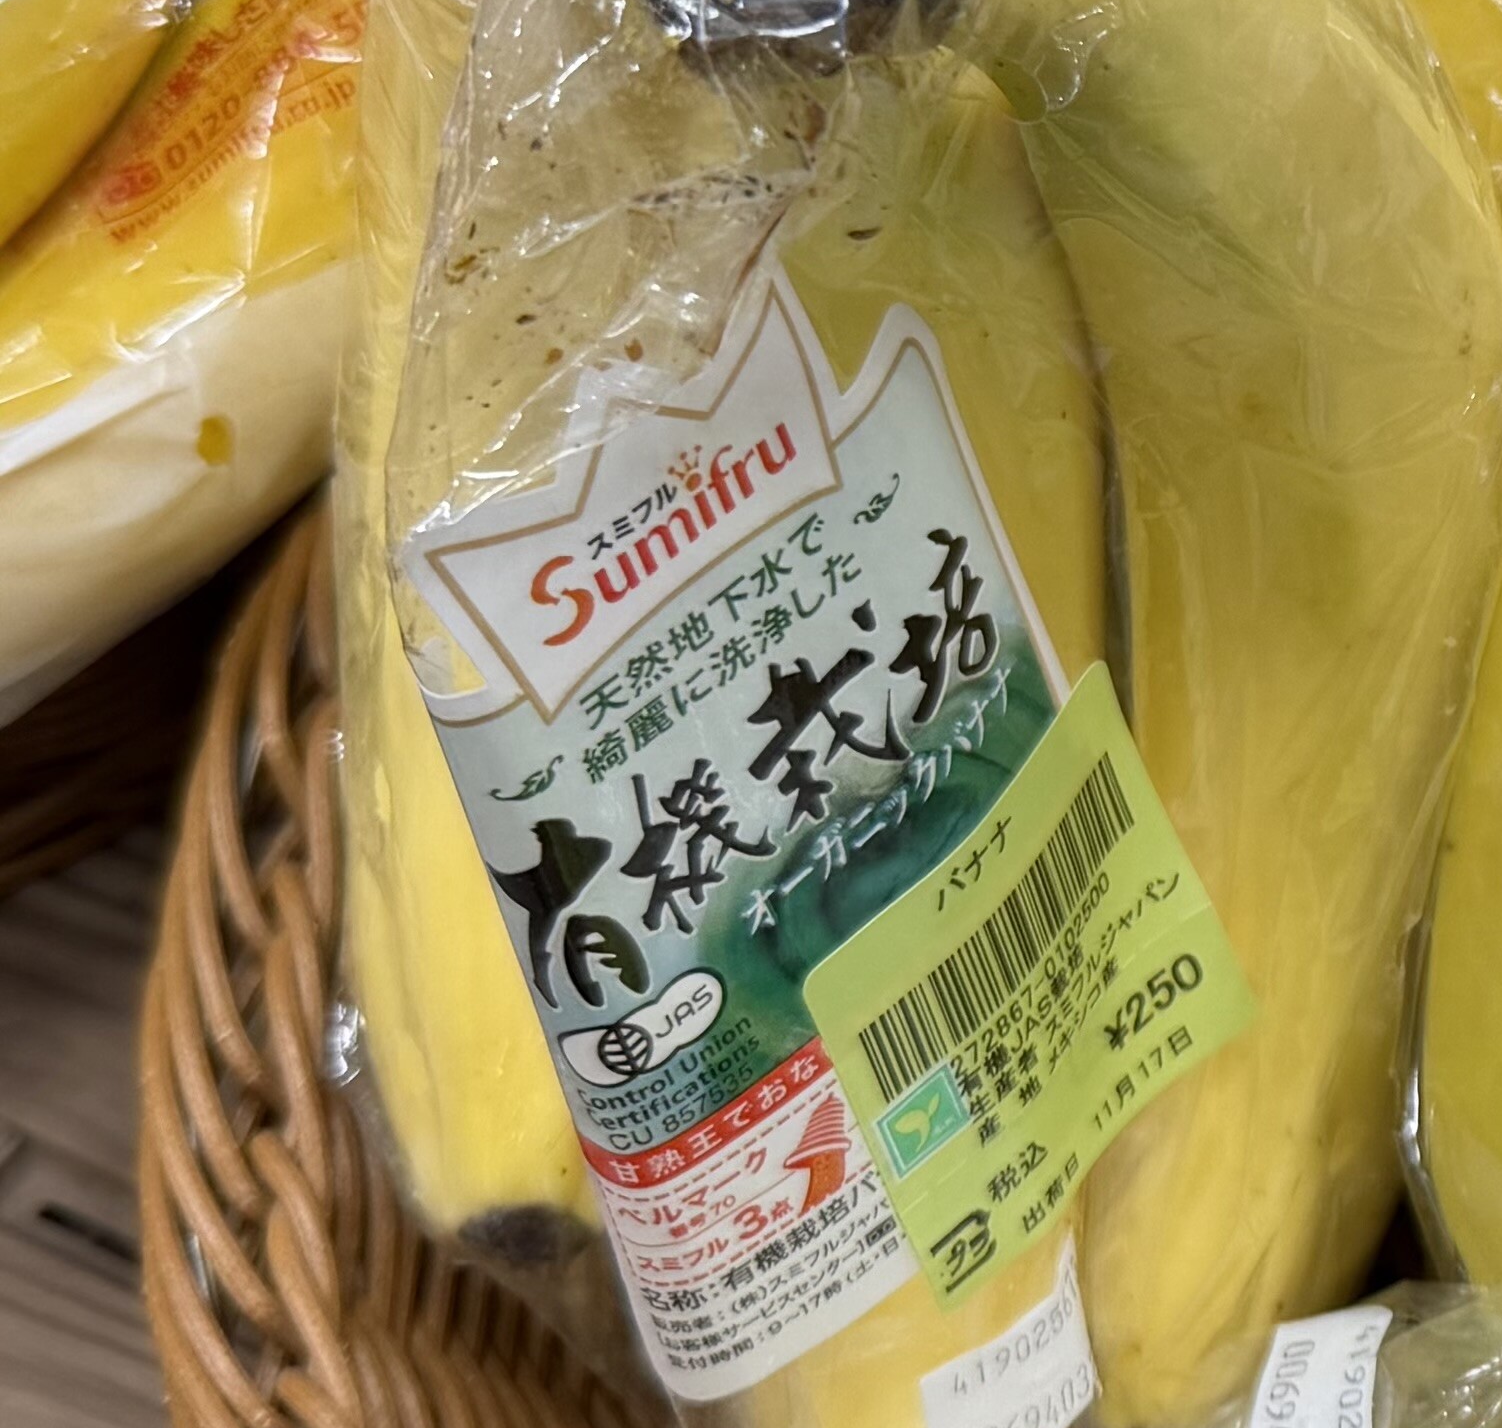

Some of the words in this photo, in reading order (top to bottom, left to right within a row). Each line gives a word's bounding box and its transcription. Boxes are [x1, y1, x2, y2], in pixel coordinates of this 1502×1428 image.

[530, 422, 797, 647] Sumifru
[587, 481, 680, 561] スミフル
[579, 511, 826, 730] 天然地下水で
[581, 552, 863, 785] 綺麗に洗浄した
[487, 528, 1000, 1011] 有機栽培
[740, 663, 1011, 936] オーガニックバナナ
[936, 813, 1013, 913] バナナ
[654, 984, 715, 1039] JAS
[679, 1016, 753, 1074] Union
[950, 870, 1112, 1080] 272867-0102500
[968, 1047, 1041, 1121] 生産者
[1043, 870, 1182, 1037] スミフルジャパン
[608, 1127, 654, 1152] CU
[662, 1063, 756, 1134] 857535
[608, 1054, 821, 1186] 甘熟王でおな
[985, 1139, 1049, 1205] 税込
[1102, 950, 1206, 1053] ¥250
[1020, 1150, 1082, 1235] 出荷日
[1091, 1024, 1195, 1131] 11月17日
[618, 1147, 769, 1227] ベルマーク
[637, 1236, 730, 1274] スミフル
[732, 1197, 794, 1242] 3点
[953, 1254, 1078, 1396] 41902567
